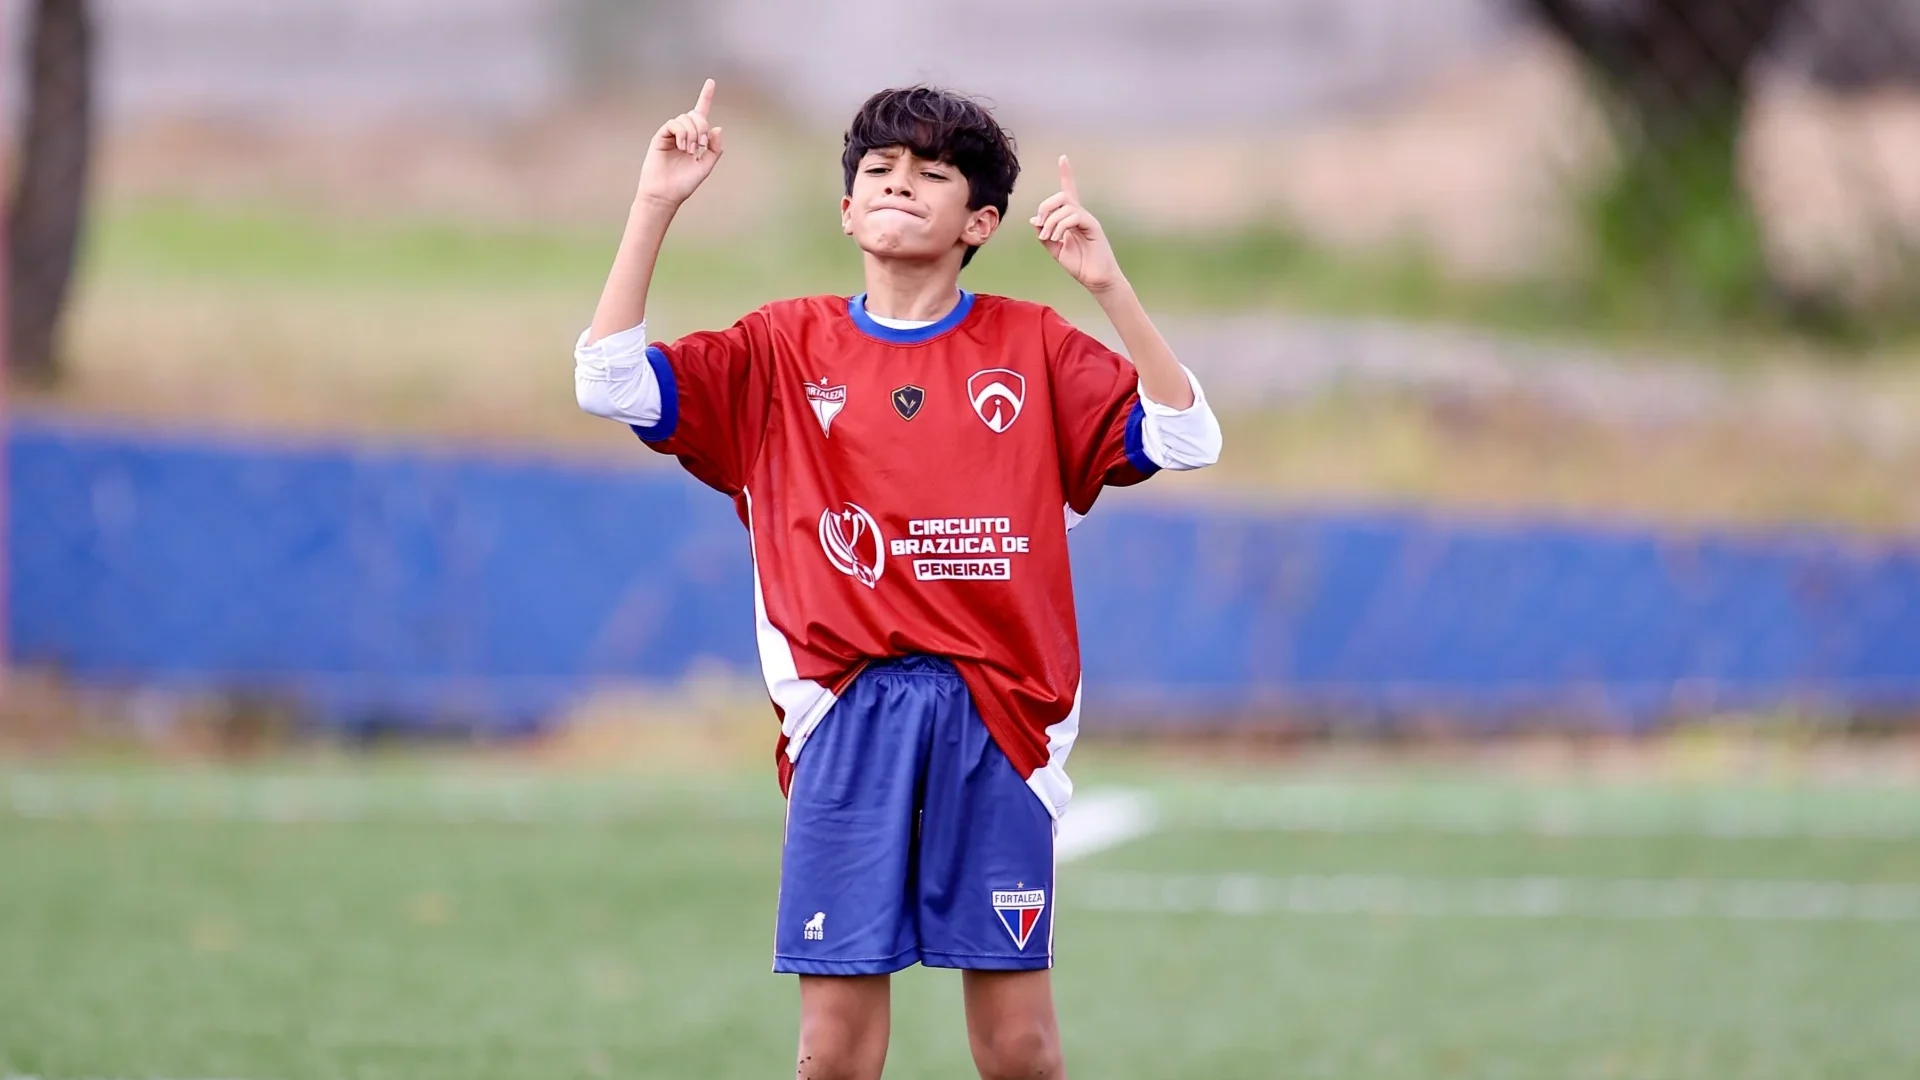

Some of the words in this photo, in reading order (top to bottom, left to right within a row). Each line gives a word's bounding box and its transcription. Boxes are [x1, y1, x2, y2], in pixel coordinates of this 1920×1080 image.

[908, 517, 1010, 535] CIRCUITO
[890, 538, 996, 556] BRAZUCA
[1001, 537, 1030, 553] DE
[918, 563, 1006, 577] PENEIRAS
[994, 893, 1043, 903] FORTALEZA
[803, 930, 824, 940] 1918
